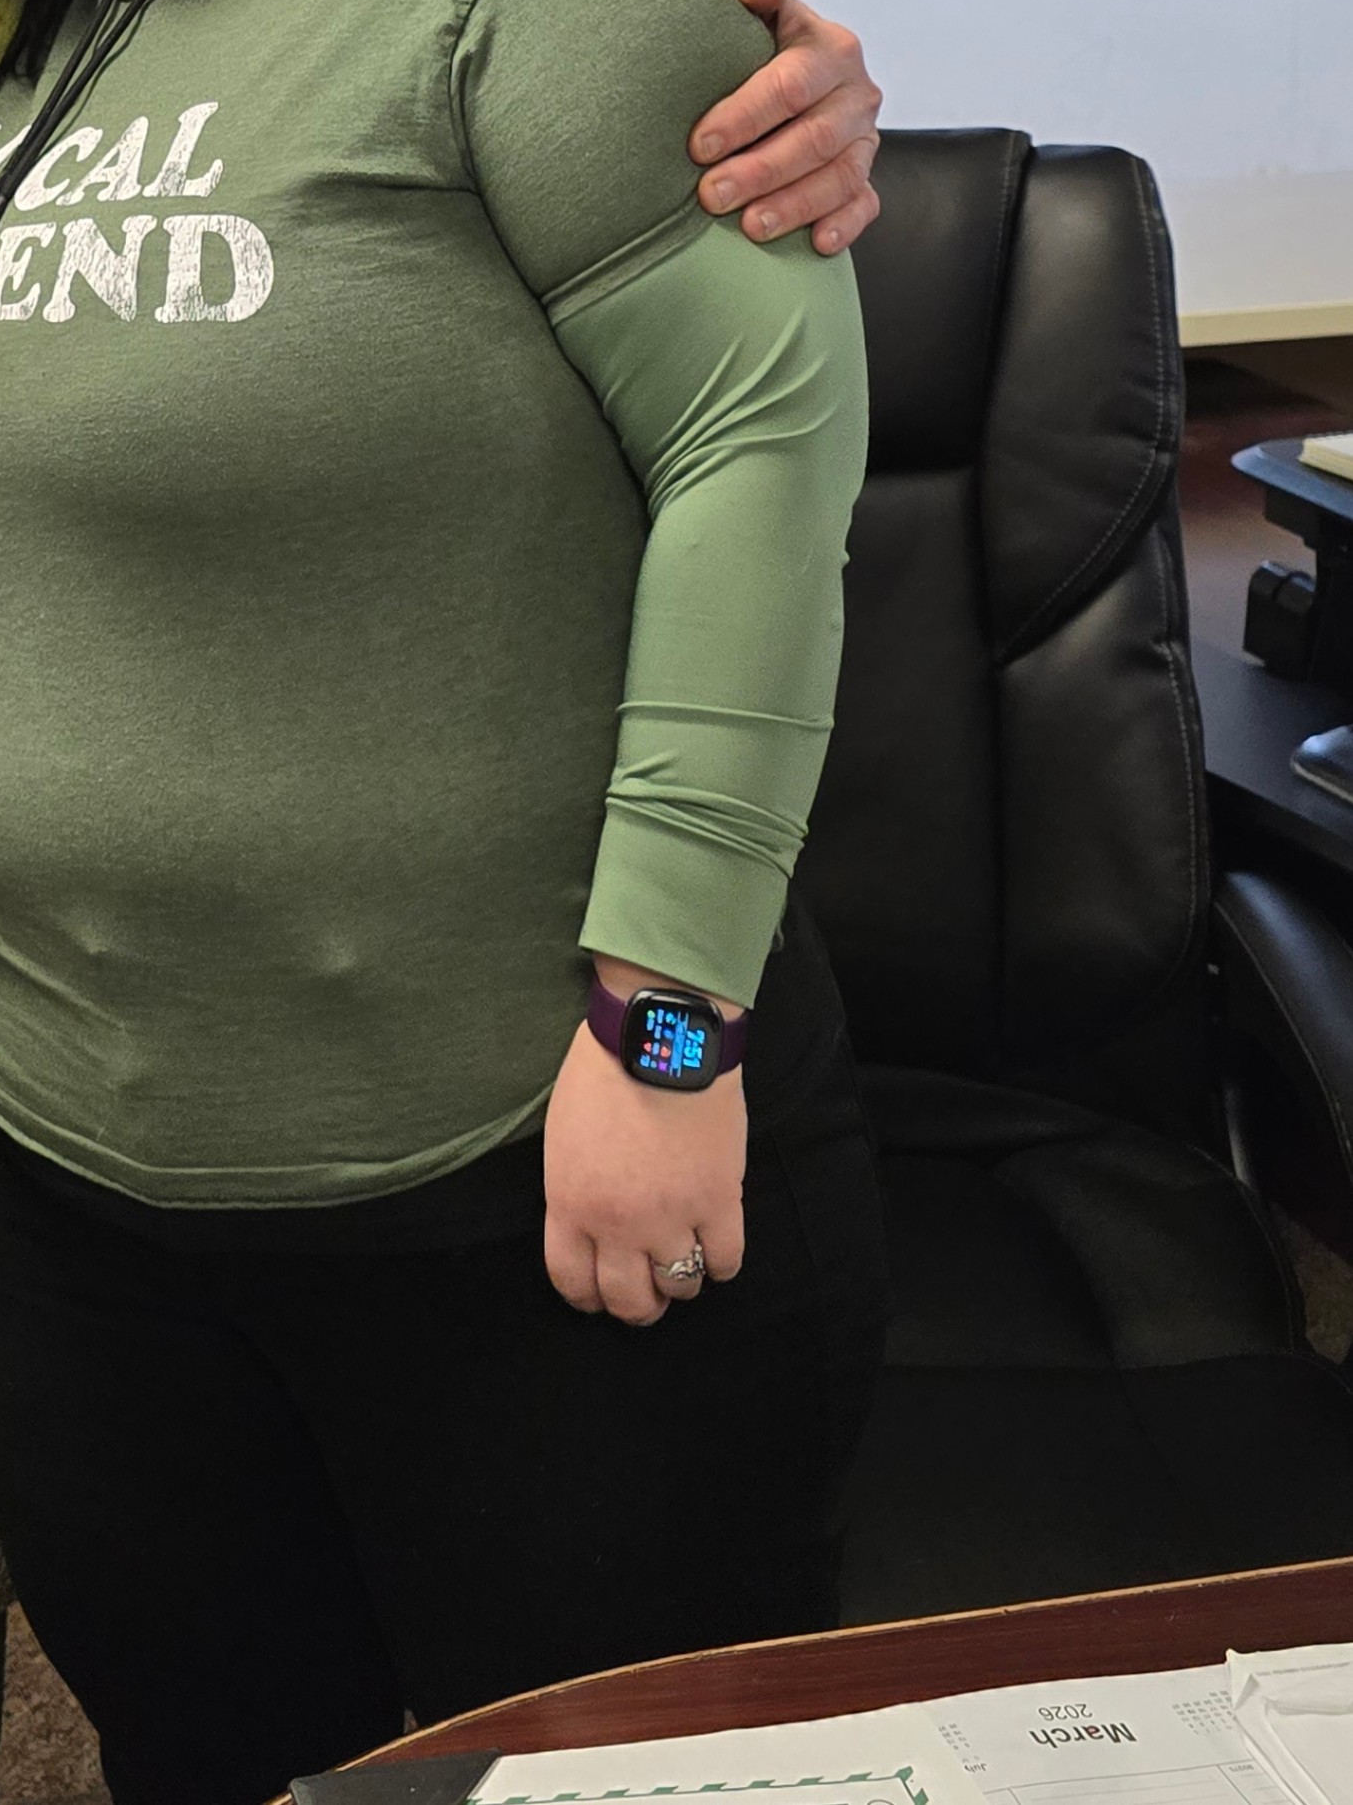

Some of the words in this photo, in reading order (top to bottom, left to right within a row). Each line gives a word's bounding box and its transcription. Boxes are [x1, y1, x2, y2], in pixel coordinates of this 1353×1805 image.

[683, 1030, 705, 1067] 7:51
[1038, 1703, 1094, 1722] 2026
[1029, 1721, 1137, 1751] March
